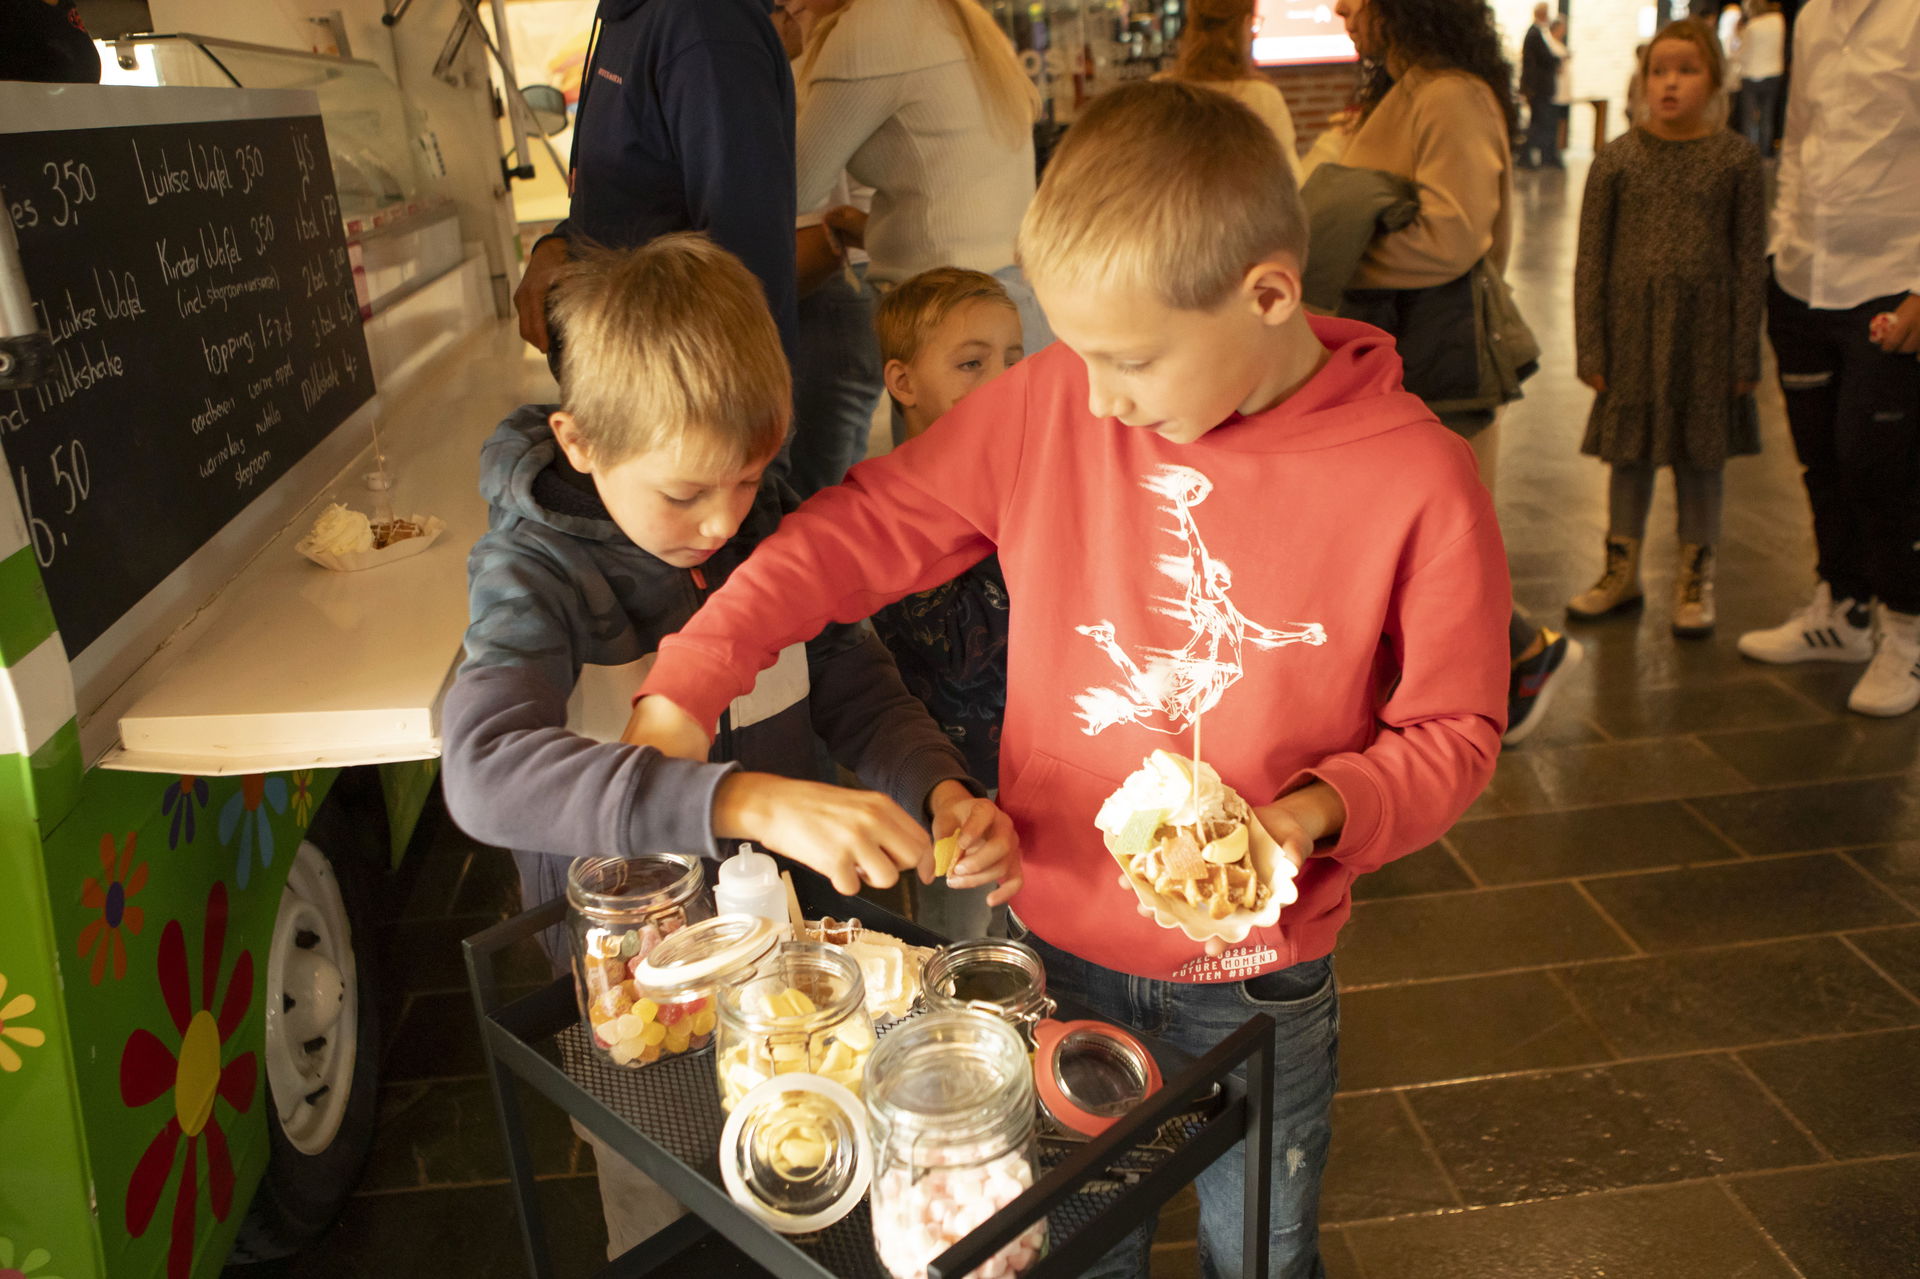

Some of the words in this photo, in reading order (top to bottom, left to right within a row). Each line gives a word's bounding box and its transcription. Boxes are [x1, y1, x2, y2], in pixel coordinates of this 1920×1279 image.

[43, 159, 96, 227] 3,50
[132, 138, 190, 205] Luikse
[187, 138, 233, 197] Wafel
[235, 145, 264, 194] 3,50
[200, 221, 242, 274] Wafel
[41, 288, 97, 345] Luikse
[93, 267, 146, 321] Wafel
[1172, 961, 1218, 978] FUTURE
[1224, 951, 1275, 969] MOMENT
[1192, 971, 1222, 982] ITEM
